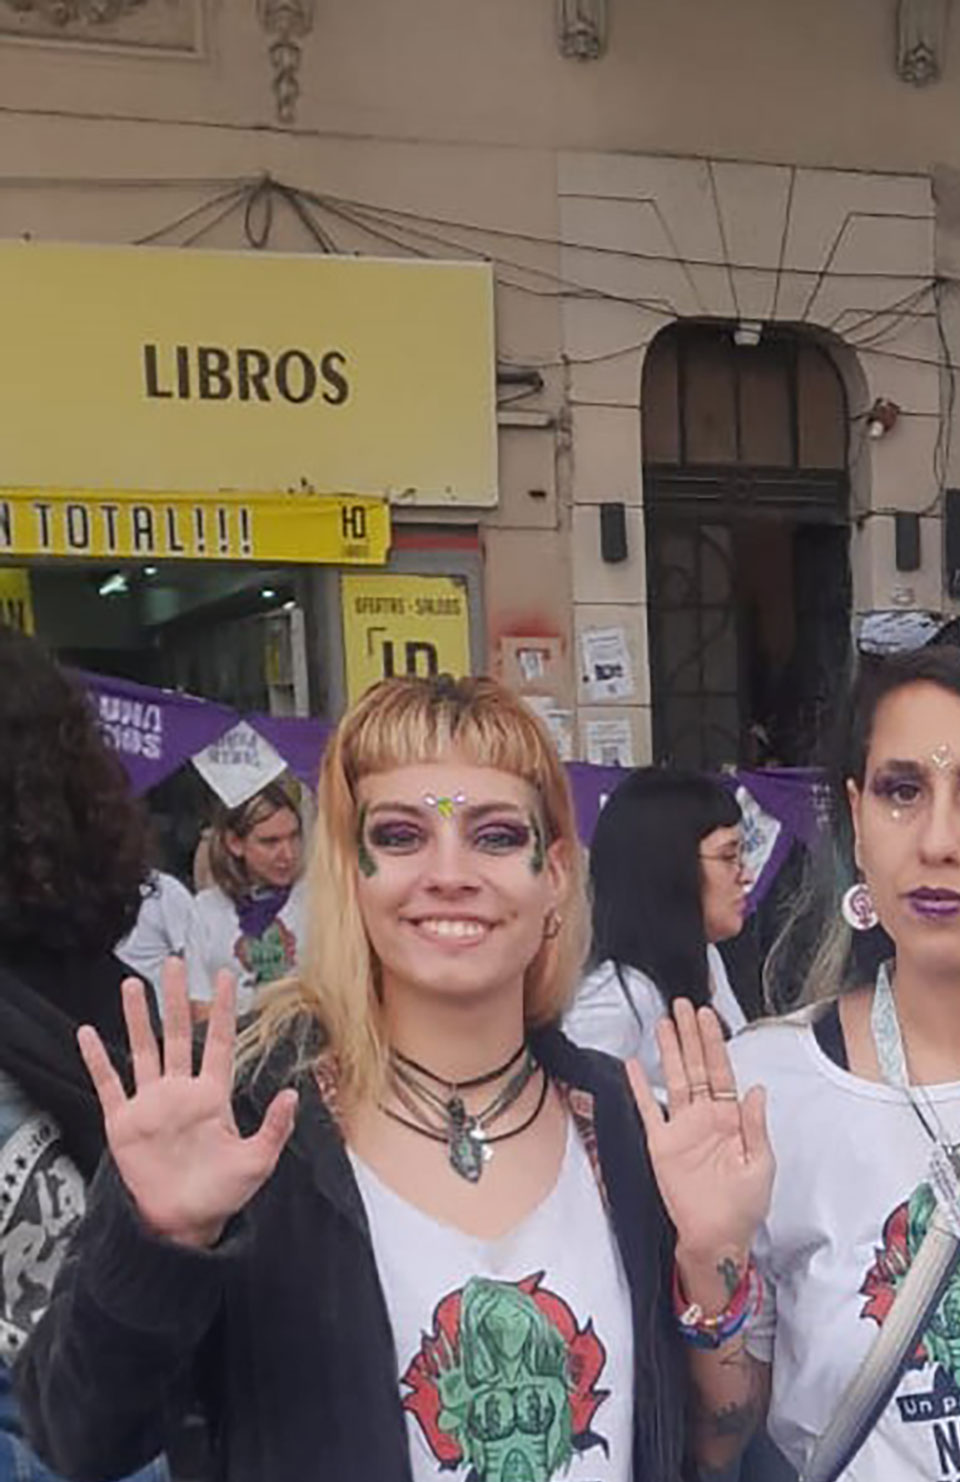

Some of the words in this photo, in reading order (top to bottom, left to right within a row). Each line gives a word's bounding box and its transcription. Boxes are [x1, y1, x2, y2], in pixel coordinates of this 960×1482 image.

[144, 344, 348, 405] LIBROS
[34, 504, 251, 553] TOTAL!!!
[903, 1399, 933, 1415] Un
